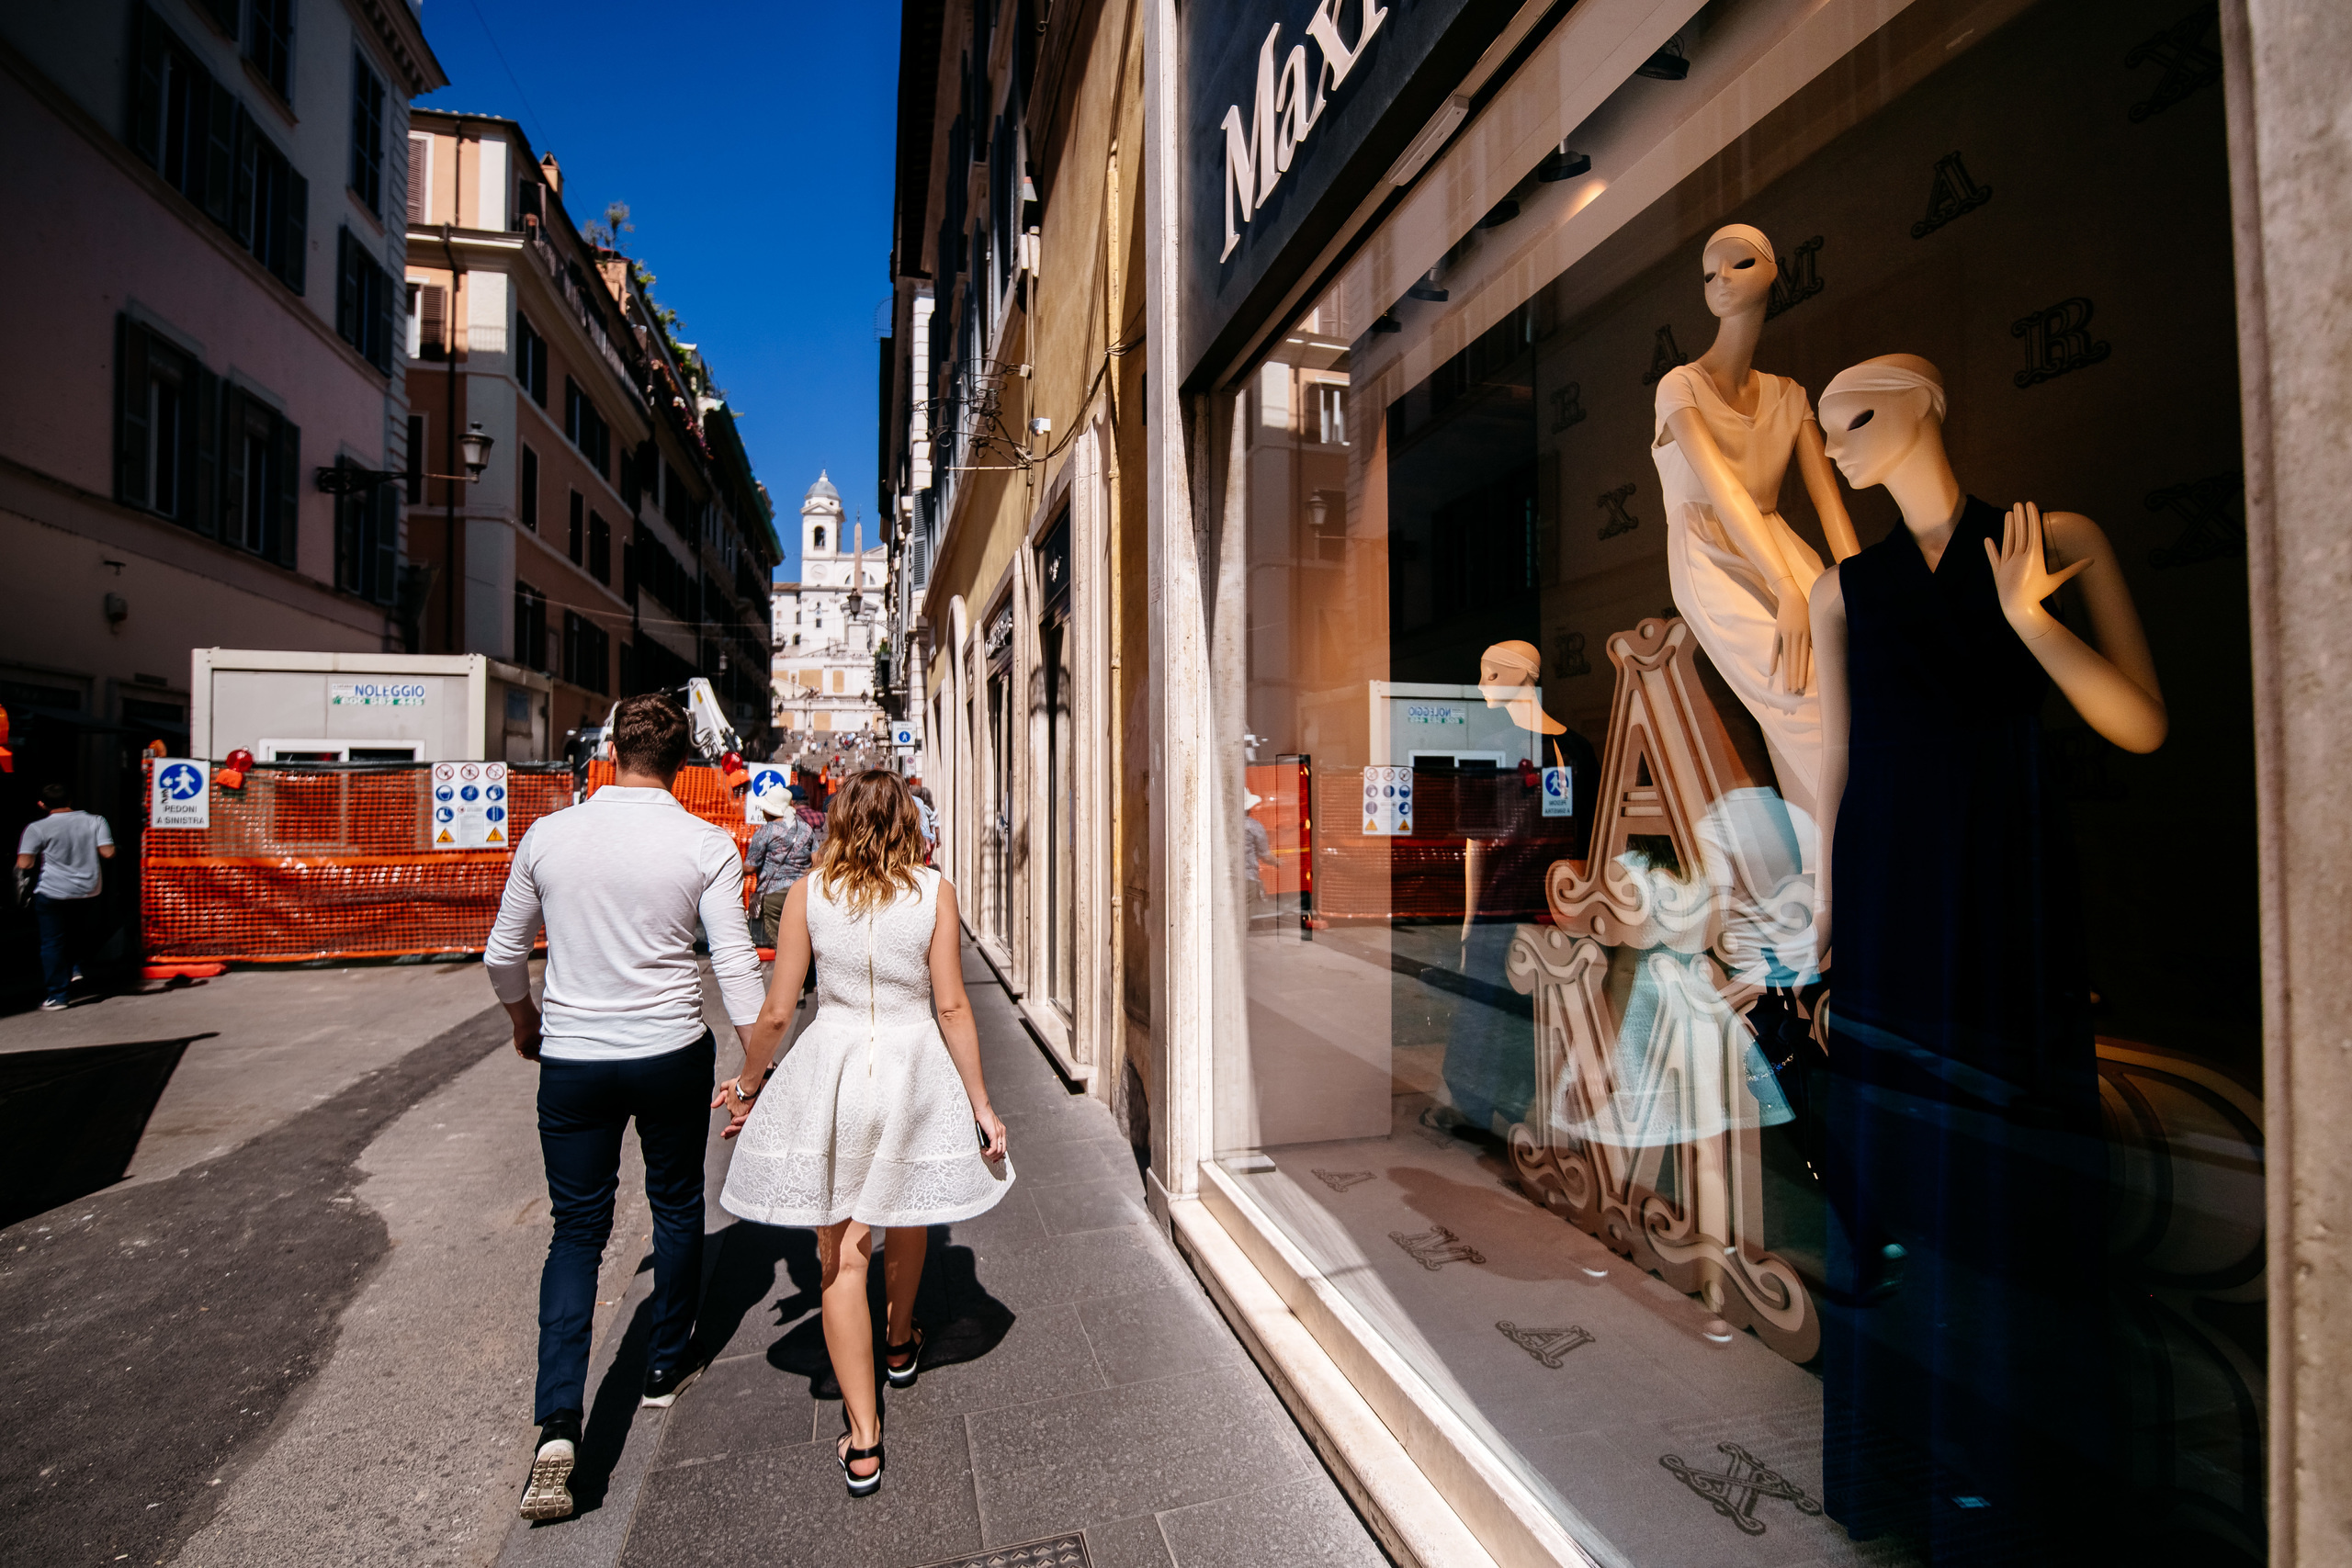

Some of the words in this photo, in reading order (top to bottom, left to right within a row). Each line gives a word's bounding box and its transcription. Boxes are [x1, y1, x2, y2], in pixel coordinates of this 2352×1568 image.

[1911, 151, 1993, 239] A
[2011, 297, 2111, 389] R
[355, 684, 425, 697] NOLEGGIO
[164, 805, 198, 813] PEDONI
[1545, 617, 1816, 955] A
[157, 816, 163, 824] A
[165, 816, 205, 824] SINISTRA
[1495, 1320, 1596, 1369] A
